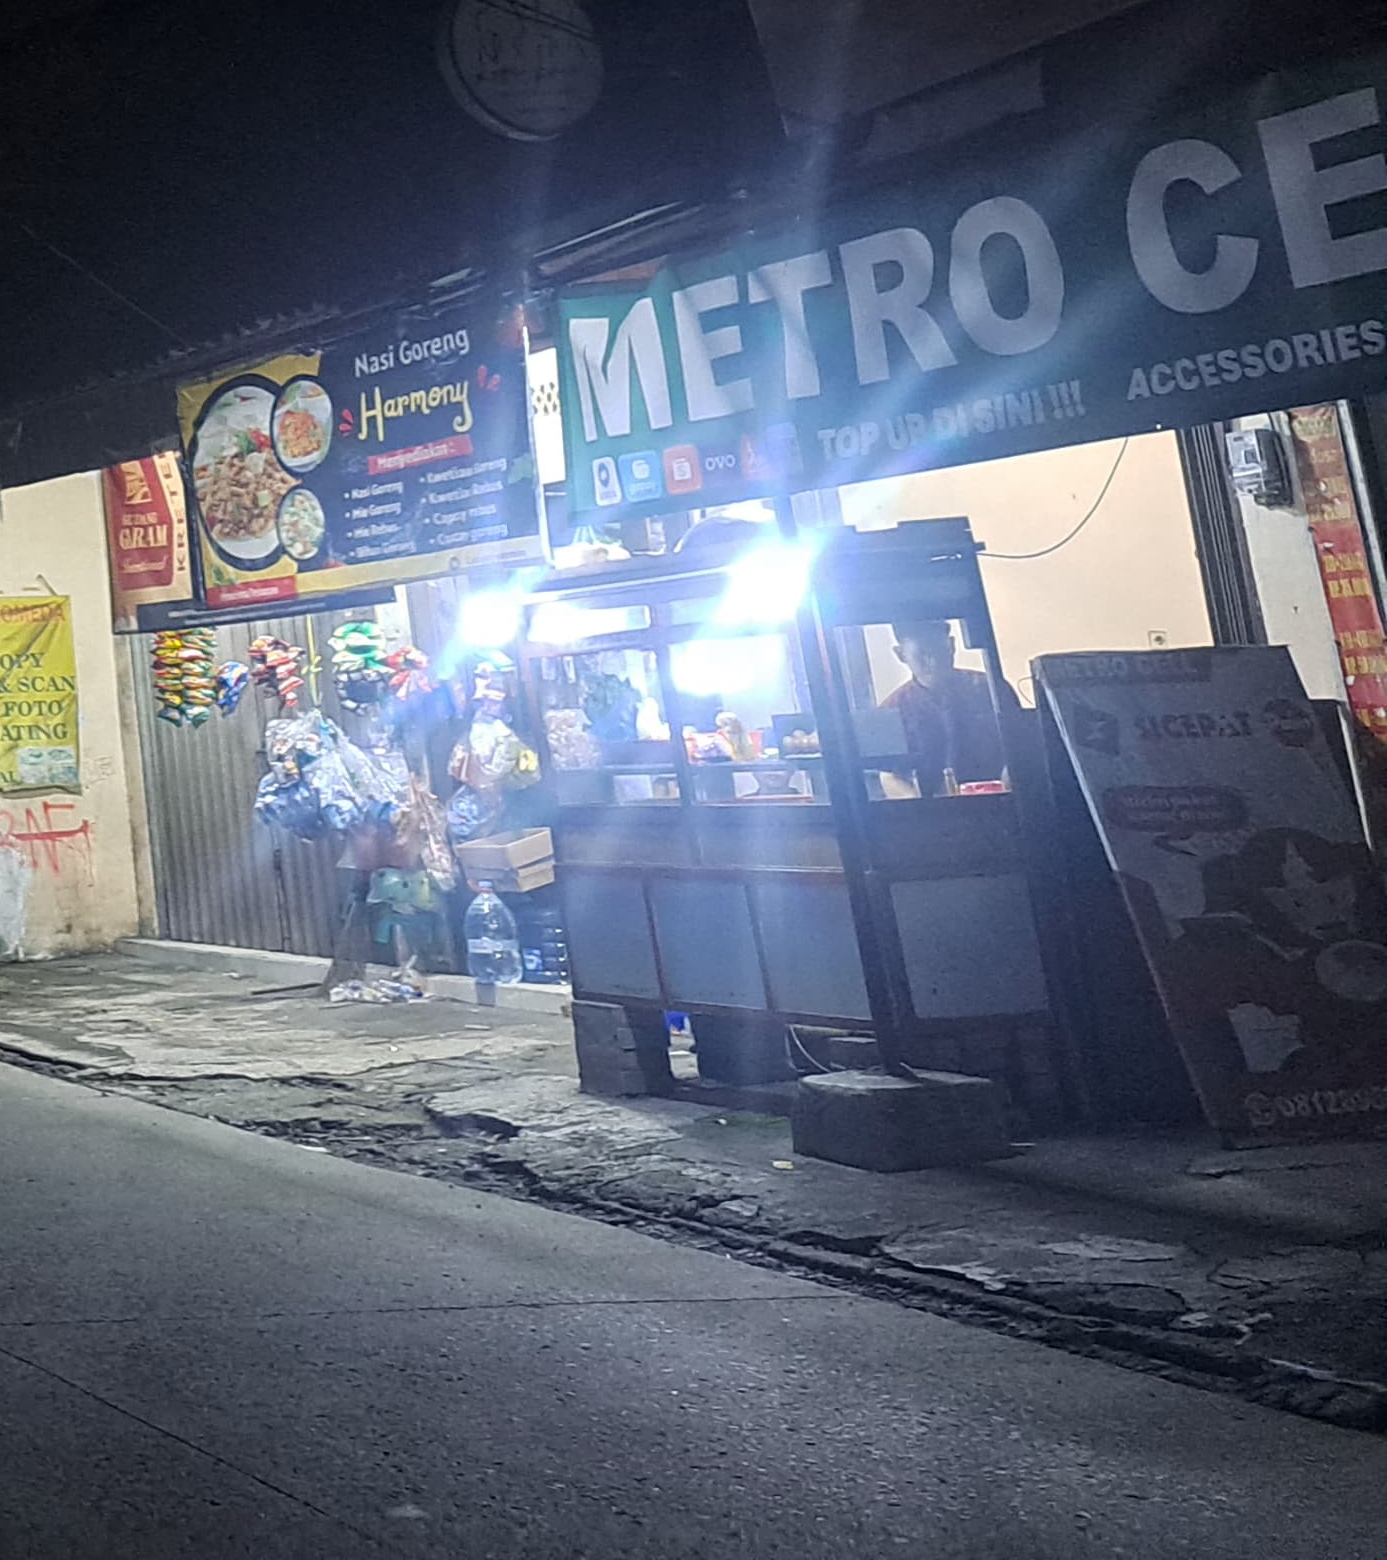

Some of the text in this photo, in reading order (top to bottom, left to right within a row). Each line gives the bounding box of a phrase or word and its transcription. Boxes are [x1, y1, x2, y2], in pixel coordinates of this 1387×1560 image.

[568, 195, 1064, 442] METRO
[354, 328, 470, 379] Nasi Goreng
[1127, 319, 1387, 401] ACCESSORIES
[358, 380, 473, 442] Harmony
[817, 420, 877, 460] TOP
[886, 411, 925, 451] UP
[972, 390, 1047, 434] SINI
[1, 699, 64, 719] FOTO
[17, 675, 76, 694] SCAN
